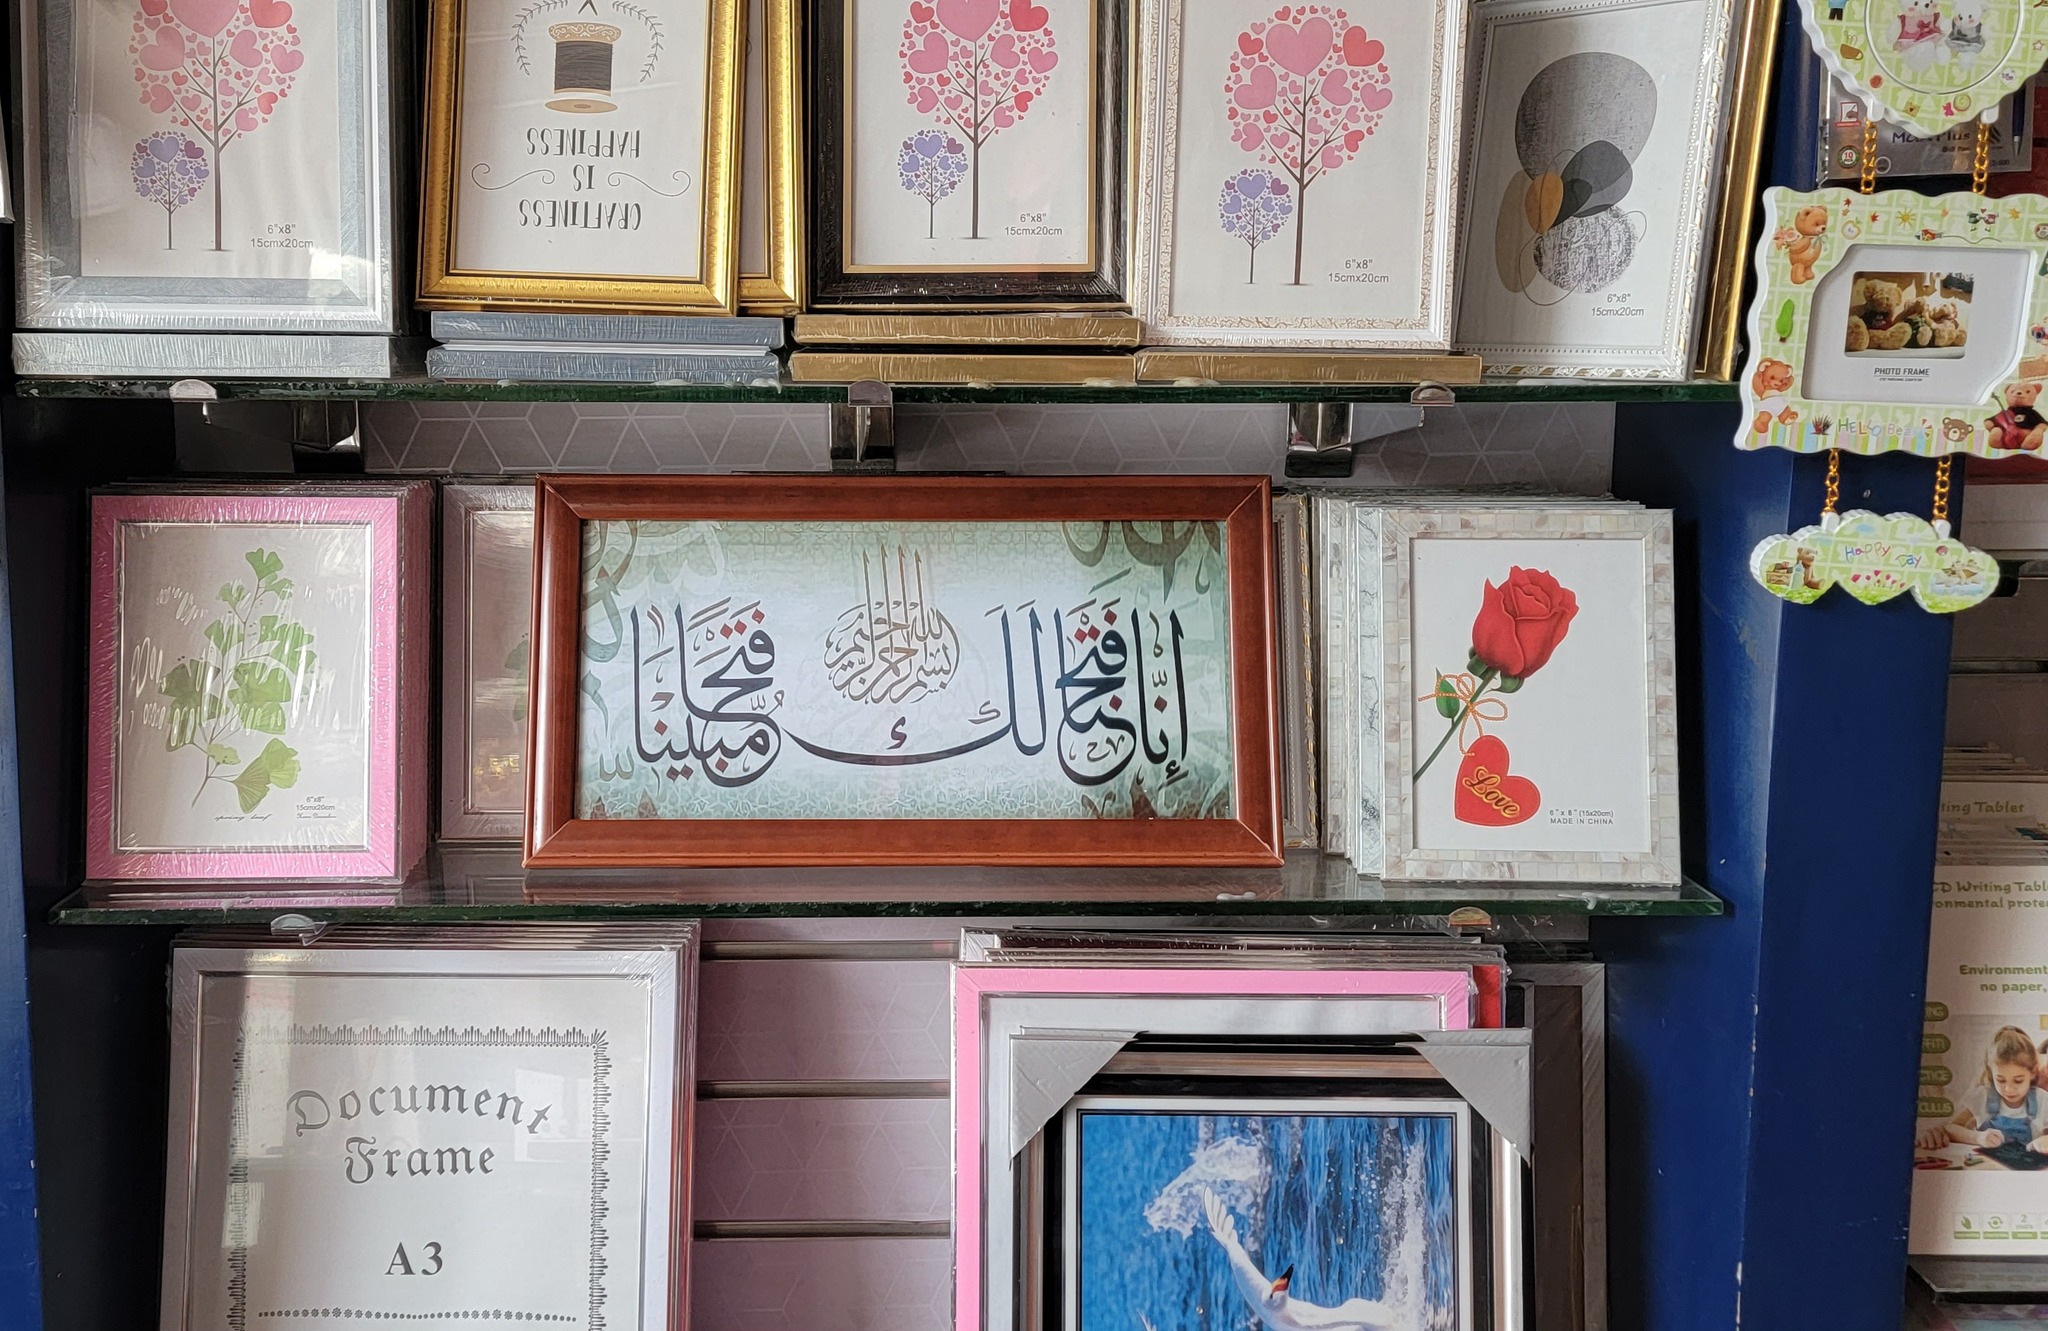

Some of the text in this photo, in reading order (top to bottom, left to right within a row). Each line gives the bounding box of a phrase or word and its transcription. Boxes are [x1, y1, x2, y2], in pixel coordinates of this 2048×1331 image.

[526, 127, 640, 158] HAPPINESS
[572, 164, 596, 192] IS
[519, 199, 642, 231] CRAFTINESS
[1020, 213, 1046, 223] 6"x8"
[267, 224, 296, 234] 6"x8"
[1005, 226, 1063, 236] 15cmx20cm
[250, 238, 314, 248] 15cmx20cm
[1345, 259, 1373, 269] 6"x8"
[1328, 273, 1389, 283] 15cmx20cm
[1591, 307, 1644, 317] 15cmx20cm
[1874, 367, 1930, 376] PHOTO FRAME
[1462, 766, 1520, 818] Love
[1973, 801, 2025, 813] Tablet
[1956, 881, 2011, 894] Writing
[2002, 983, 2048, 993] paper,
[286, 1083, 552, 1137] Document
[343, 1136, 495, 1184] Frame
[384, 1240, 444, 1276] A3
